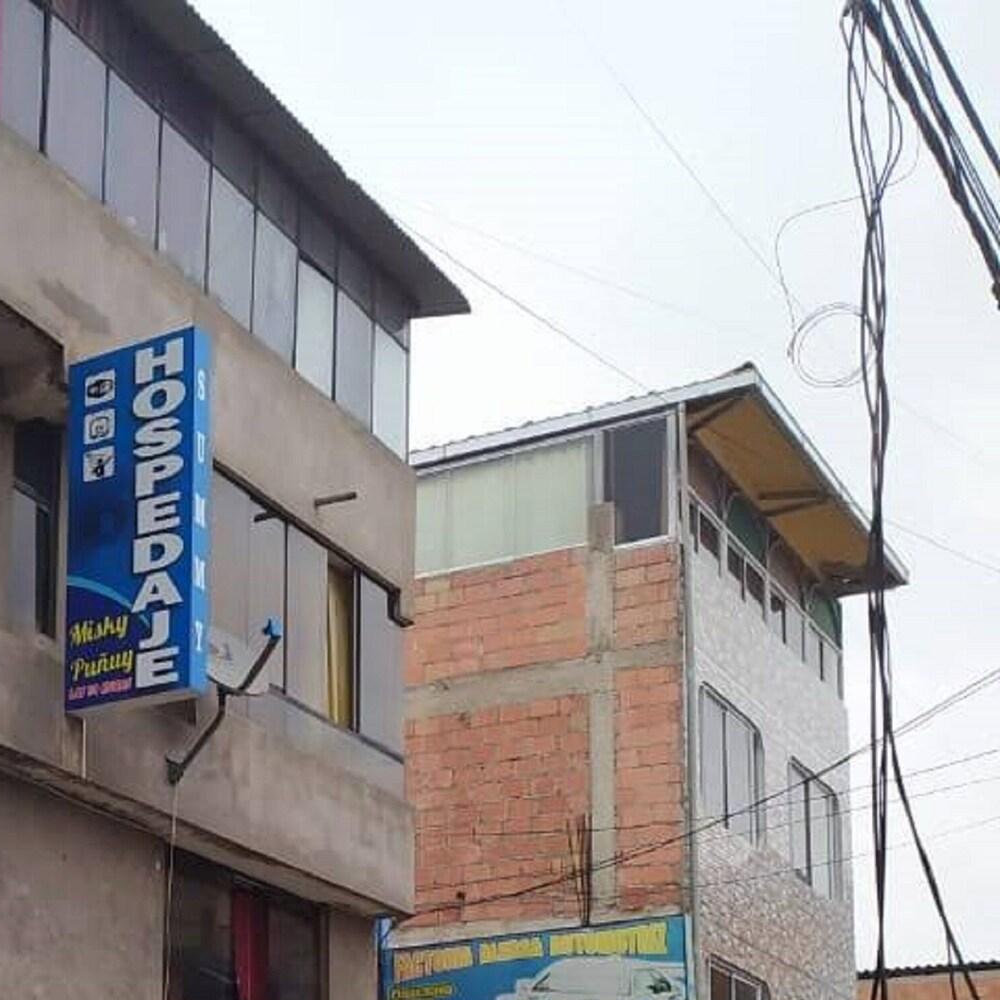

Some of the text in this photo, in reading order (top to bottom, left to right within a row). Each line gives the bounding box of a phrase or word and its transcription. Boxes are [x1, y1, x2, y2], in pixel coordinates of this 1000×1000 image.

[132, 337, 187, 689] HOSPEDAJE
[71, 615, 129, 647] Misky
[70, 650, 134, 682] Puñuy
